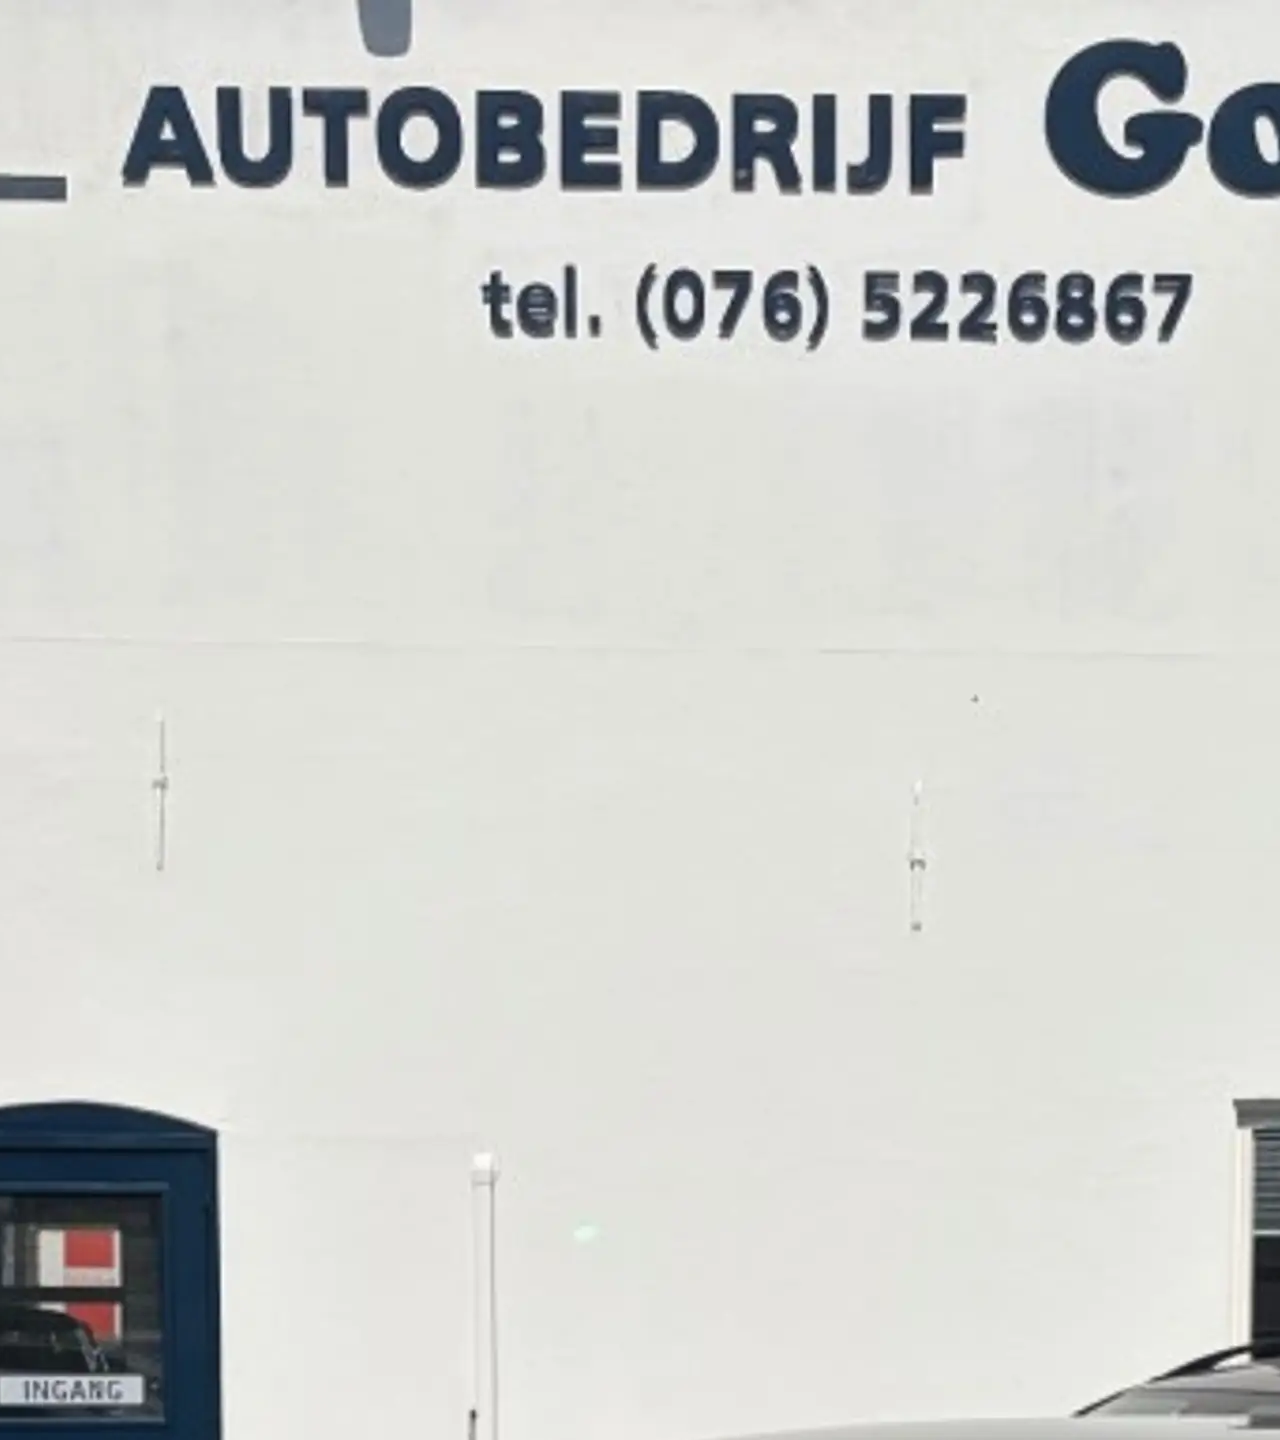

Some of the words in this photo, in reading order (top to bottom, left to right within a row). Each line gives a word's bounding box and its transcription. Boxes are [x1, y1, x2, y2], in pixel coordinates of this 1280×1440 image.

[122, 84, 967, 196] AUTOBEDRIJF
[481, 264, 602, 340] tel.
[635, 263, 830, 351] (076)
[861, 270, 1194, 346] 5226867
[23, 1379, 124, 1402] INGANG
